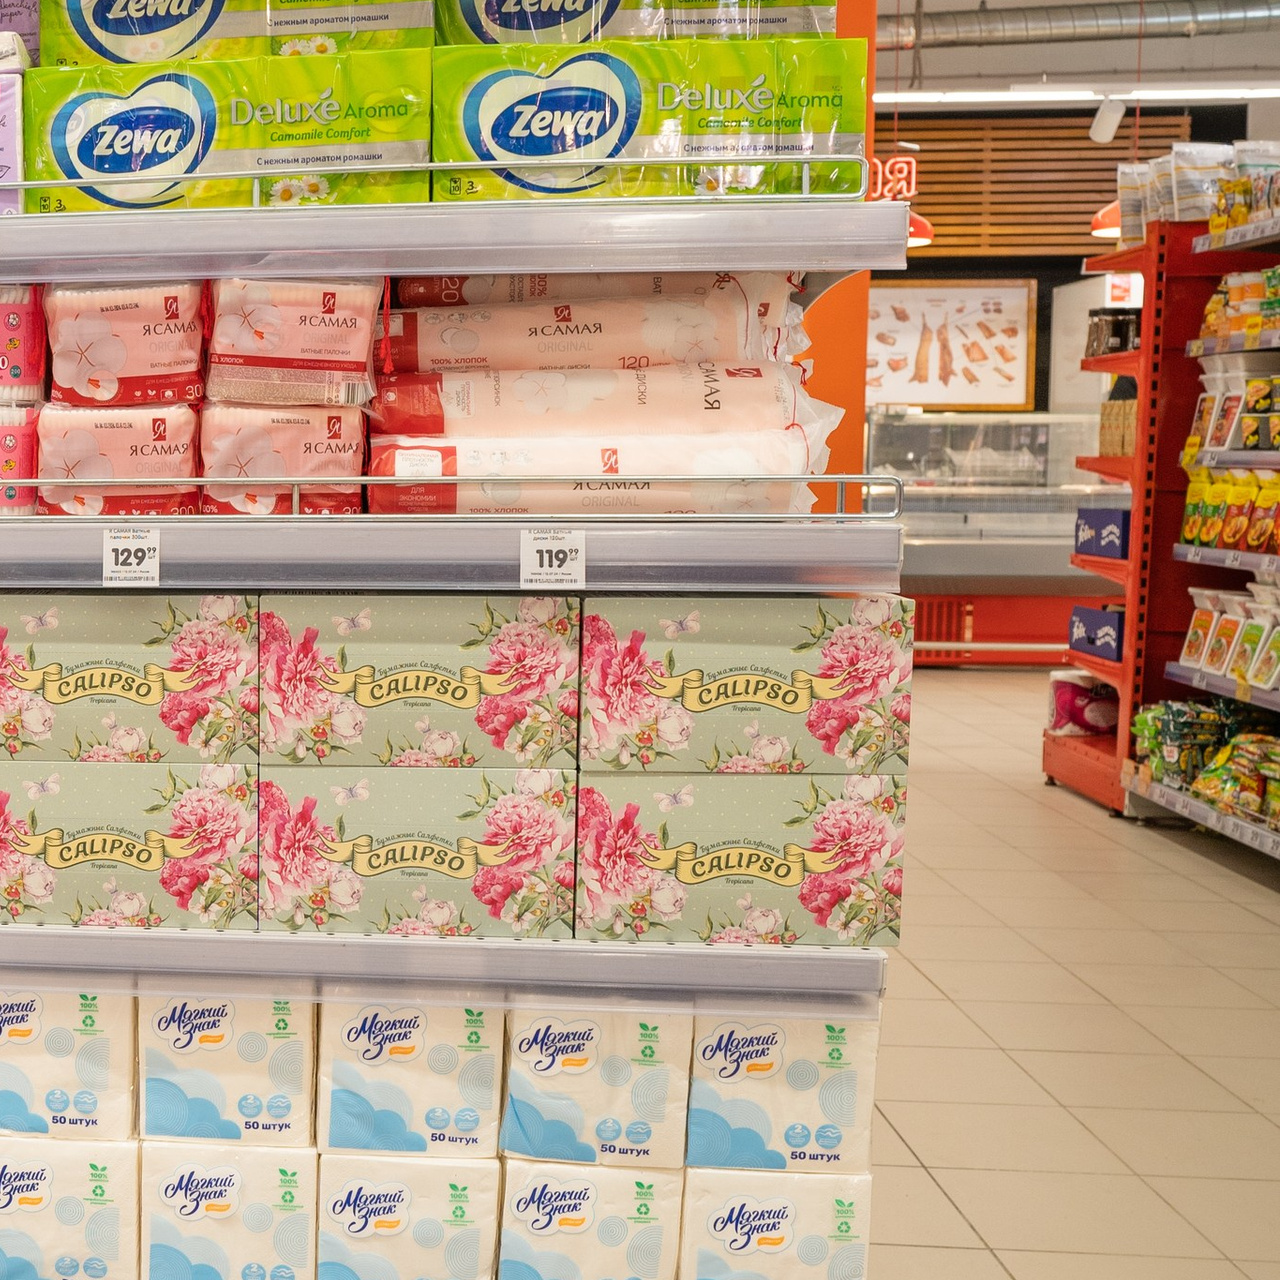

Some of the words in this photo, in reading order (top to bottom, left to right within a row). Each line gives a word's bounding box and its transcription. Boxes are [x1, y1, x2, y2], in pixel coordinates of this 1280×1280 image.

[343, 102, 408, 119] Aroma
[508, 105, 604, 137] Zewa
[93, 124, 182, 155] Zewa
[270, 129, 323, 142] Camomile
[325, 126, 371, 140] Comfort
[257, 157, 262, 165] С
[263, 155, 296, 165] нежным
[298, 154, 341, 165] ароматом
[342, 152, 383, 161] ромашки
[130, 445, 140, 456] Я
[142, 443, 189, 456] САМАЯ
[111, 548, 146, 567] 129
[535, 549, 568, 568] 119
